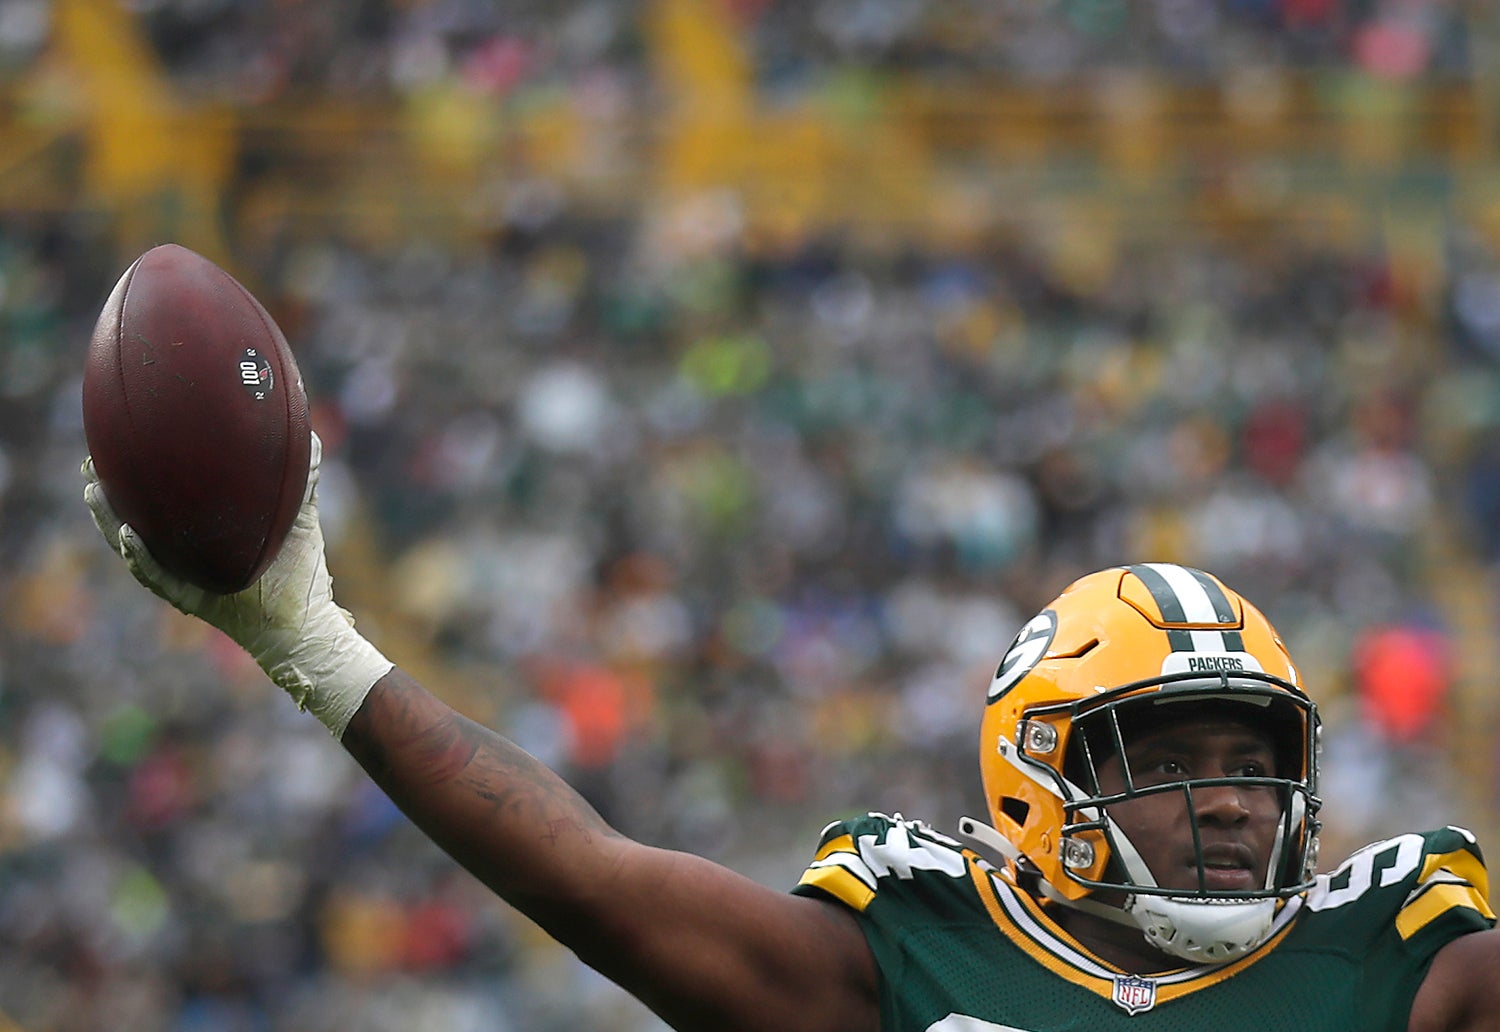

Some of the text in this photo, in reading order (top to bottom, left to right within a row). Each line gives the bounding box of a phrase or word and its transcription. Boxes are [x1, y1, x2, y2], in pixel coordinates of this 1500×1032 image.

[240, 361, 260, 385] 100
[1188, 656, 1244, 672] PACKERS
[1121, 984, 1149, 1006] NFL
